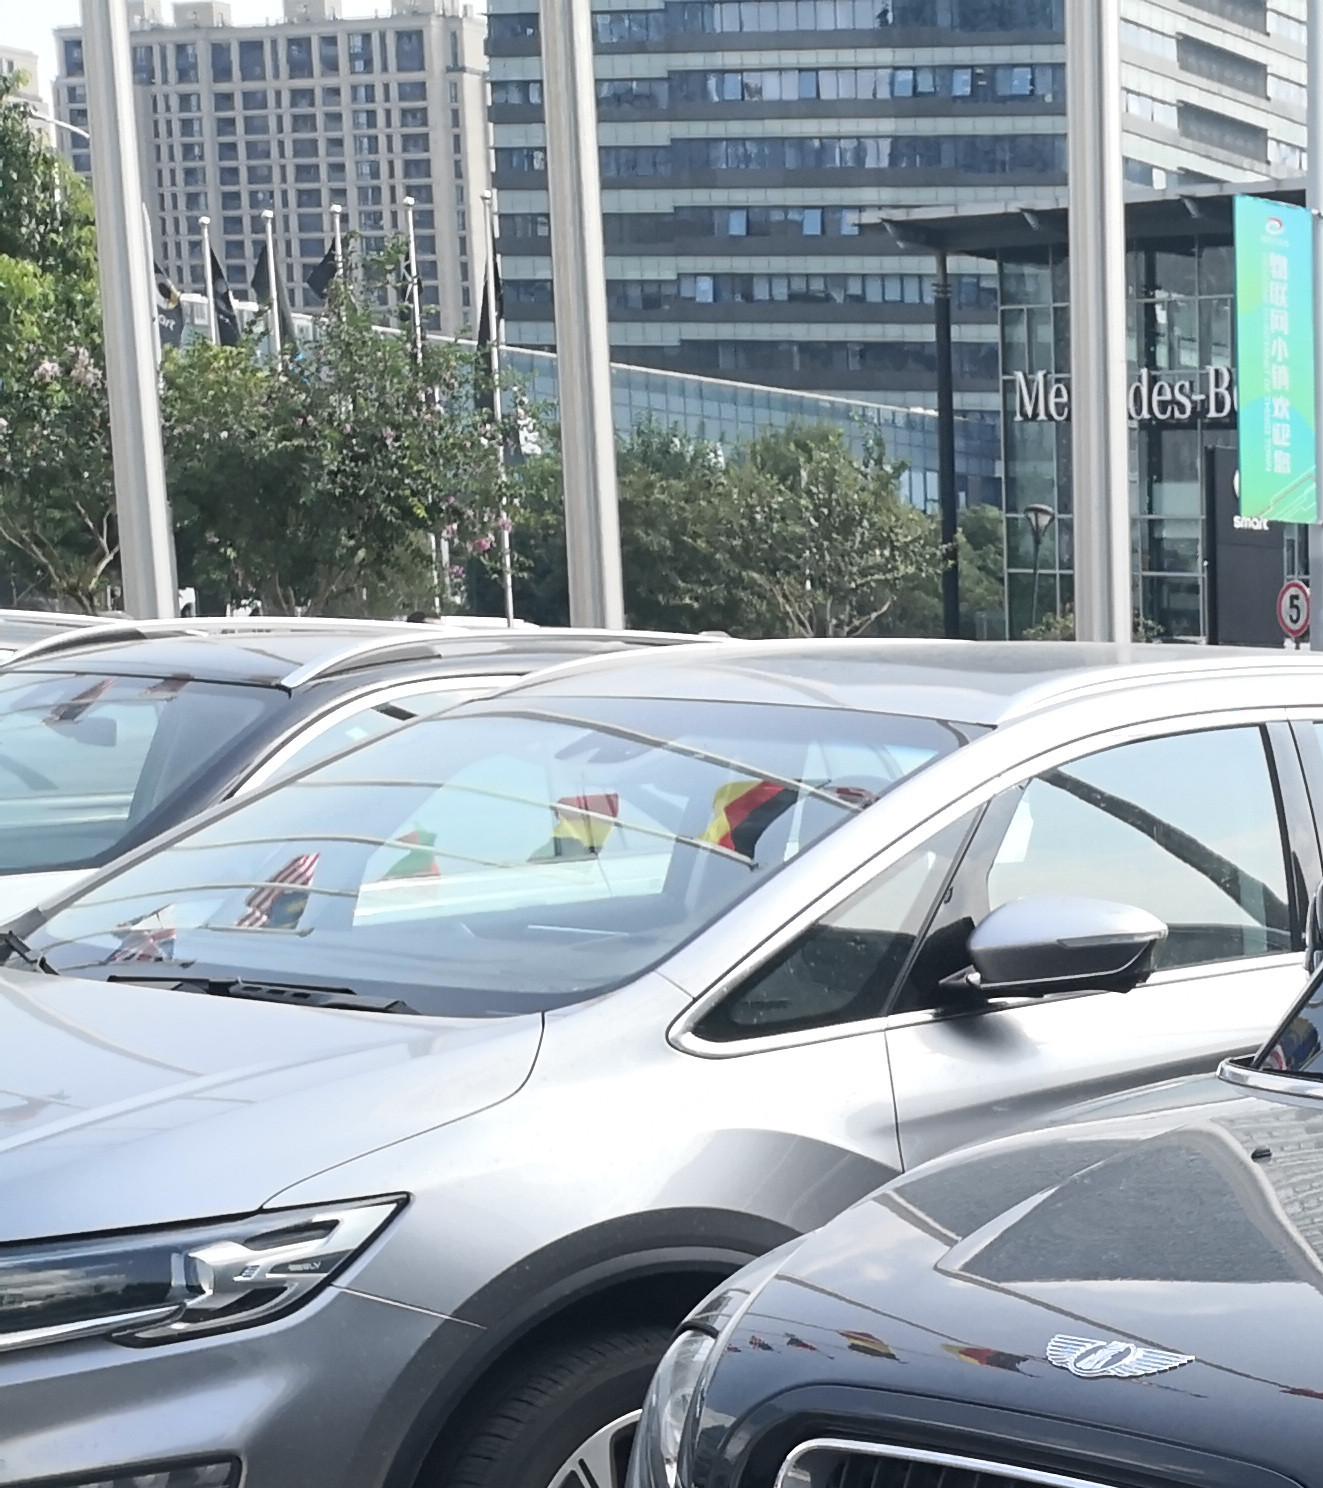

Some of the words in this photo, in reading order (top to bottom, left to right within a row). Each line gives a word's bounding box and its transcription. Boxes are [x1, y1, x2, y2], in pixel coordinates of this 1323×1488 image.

[1013, 366, 1238, 422] Medes-B
[1233, 515, 1269, 531] smart
[1289, 594, 1301, 626] 5
